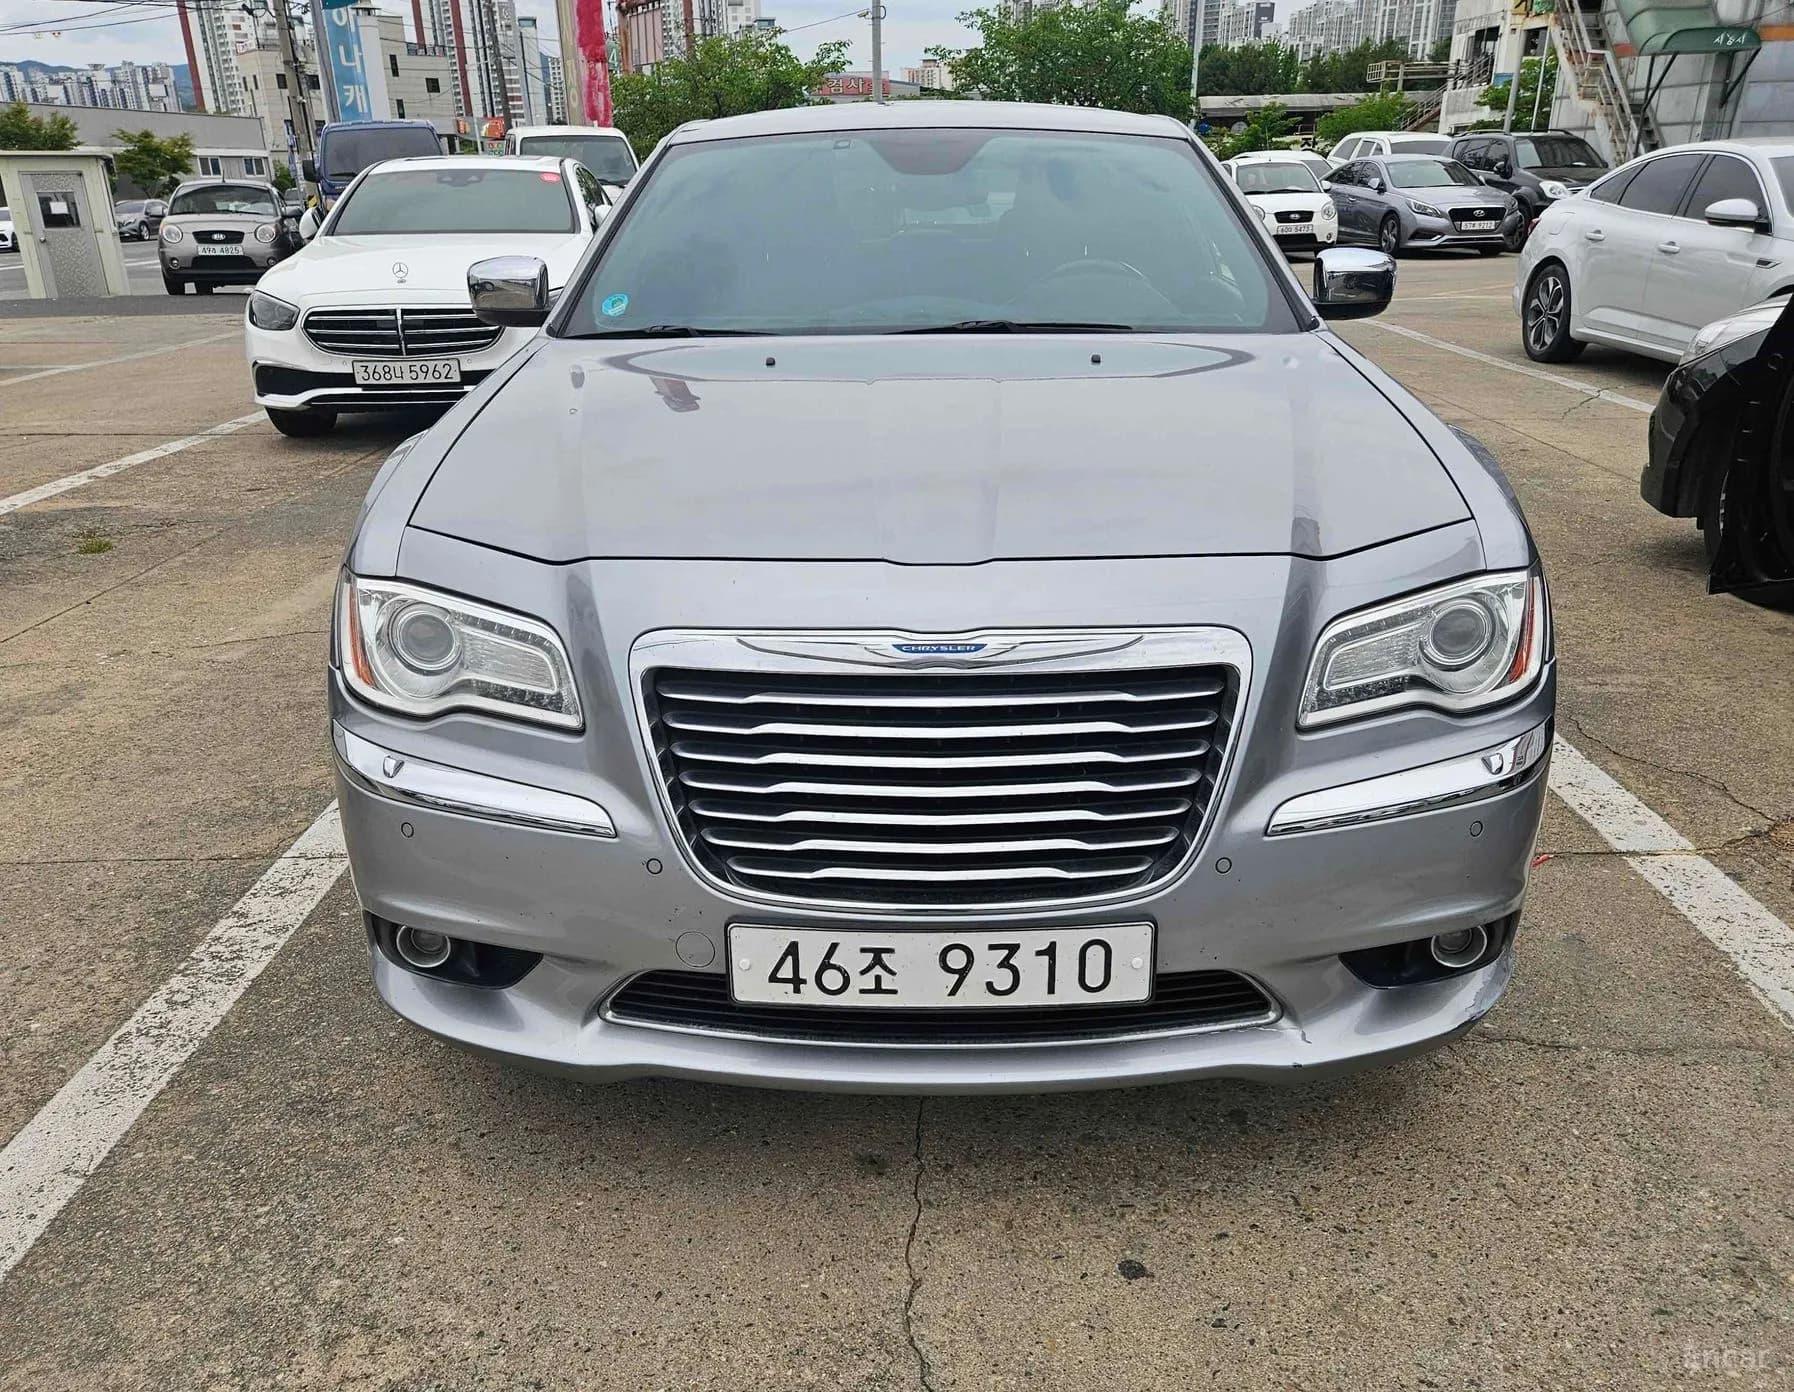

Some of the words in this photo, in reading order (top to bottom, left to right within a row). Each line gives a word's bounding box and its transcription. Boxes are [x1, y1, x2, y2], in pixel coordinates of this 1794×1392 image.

[360, 364, 403, 381] 368나
[408, 363, 453, 381] 5962
[768, 940, 898, 996] 46조
[938, 938, 1113, 996] 9310
